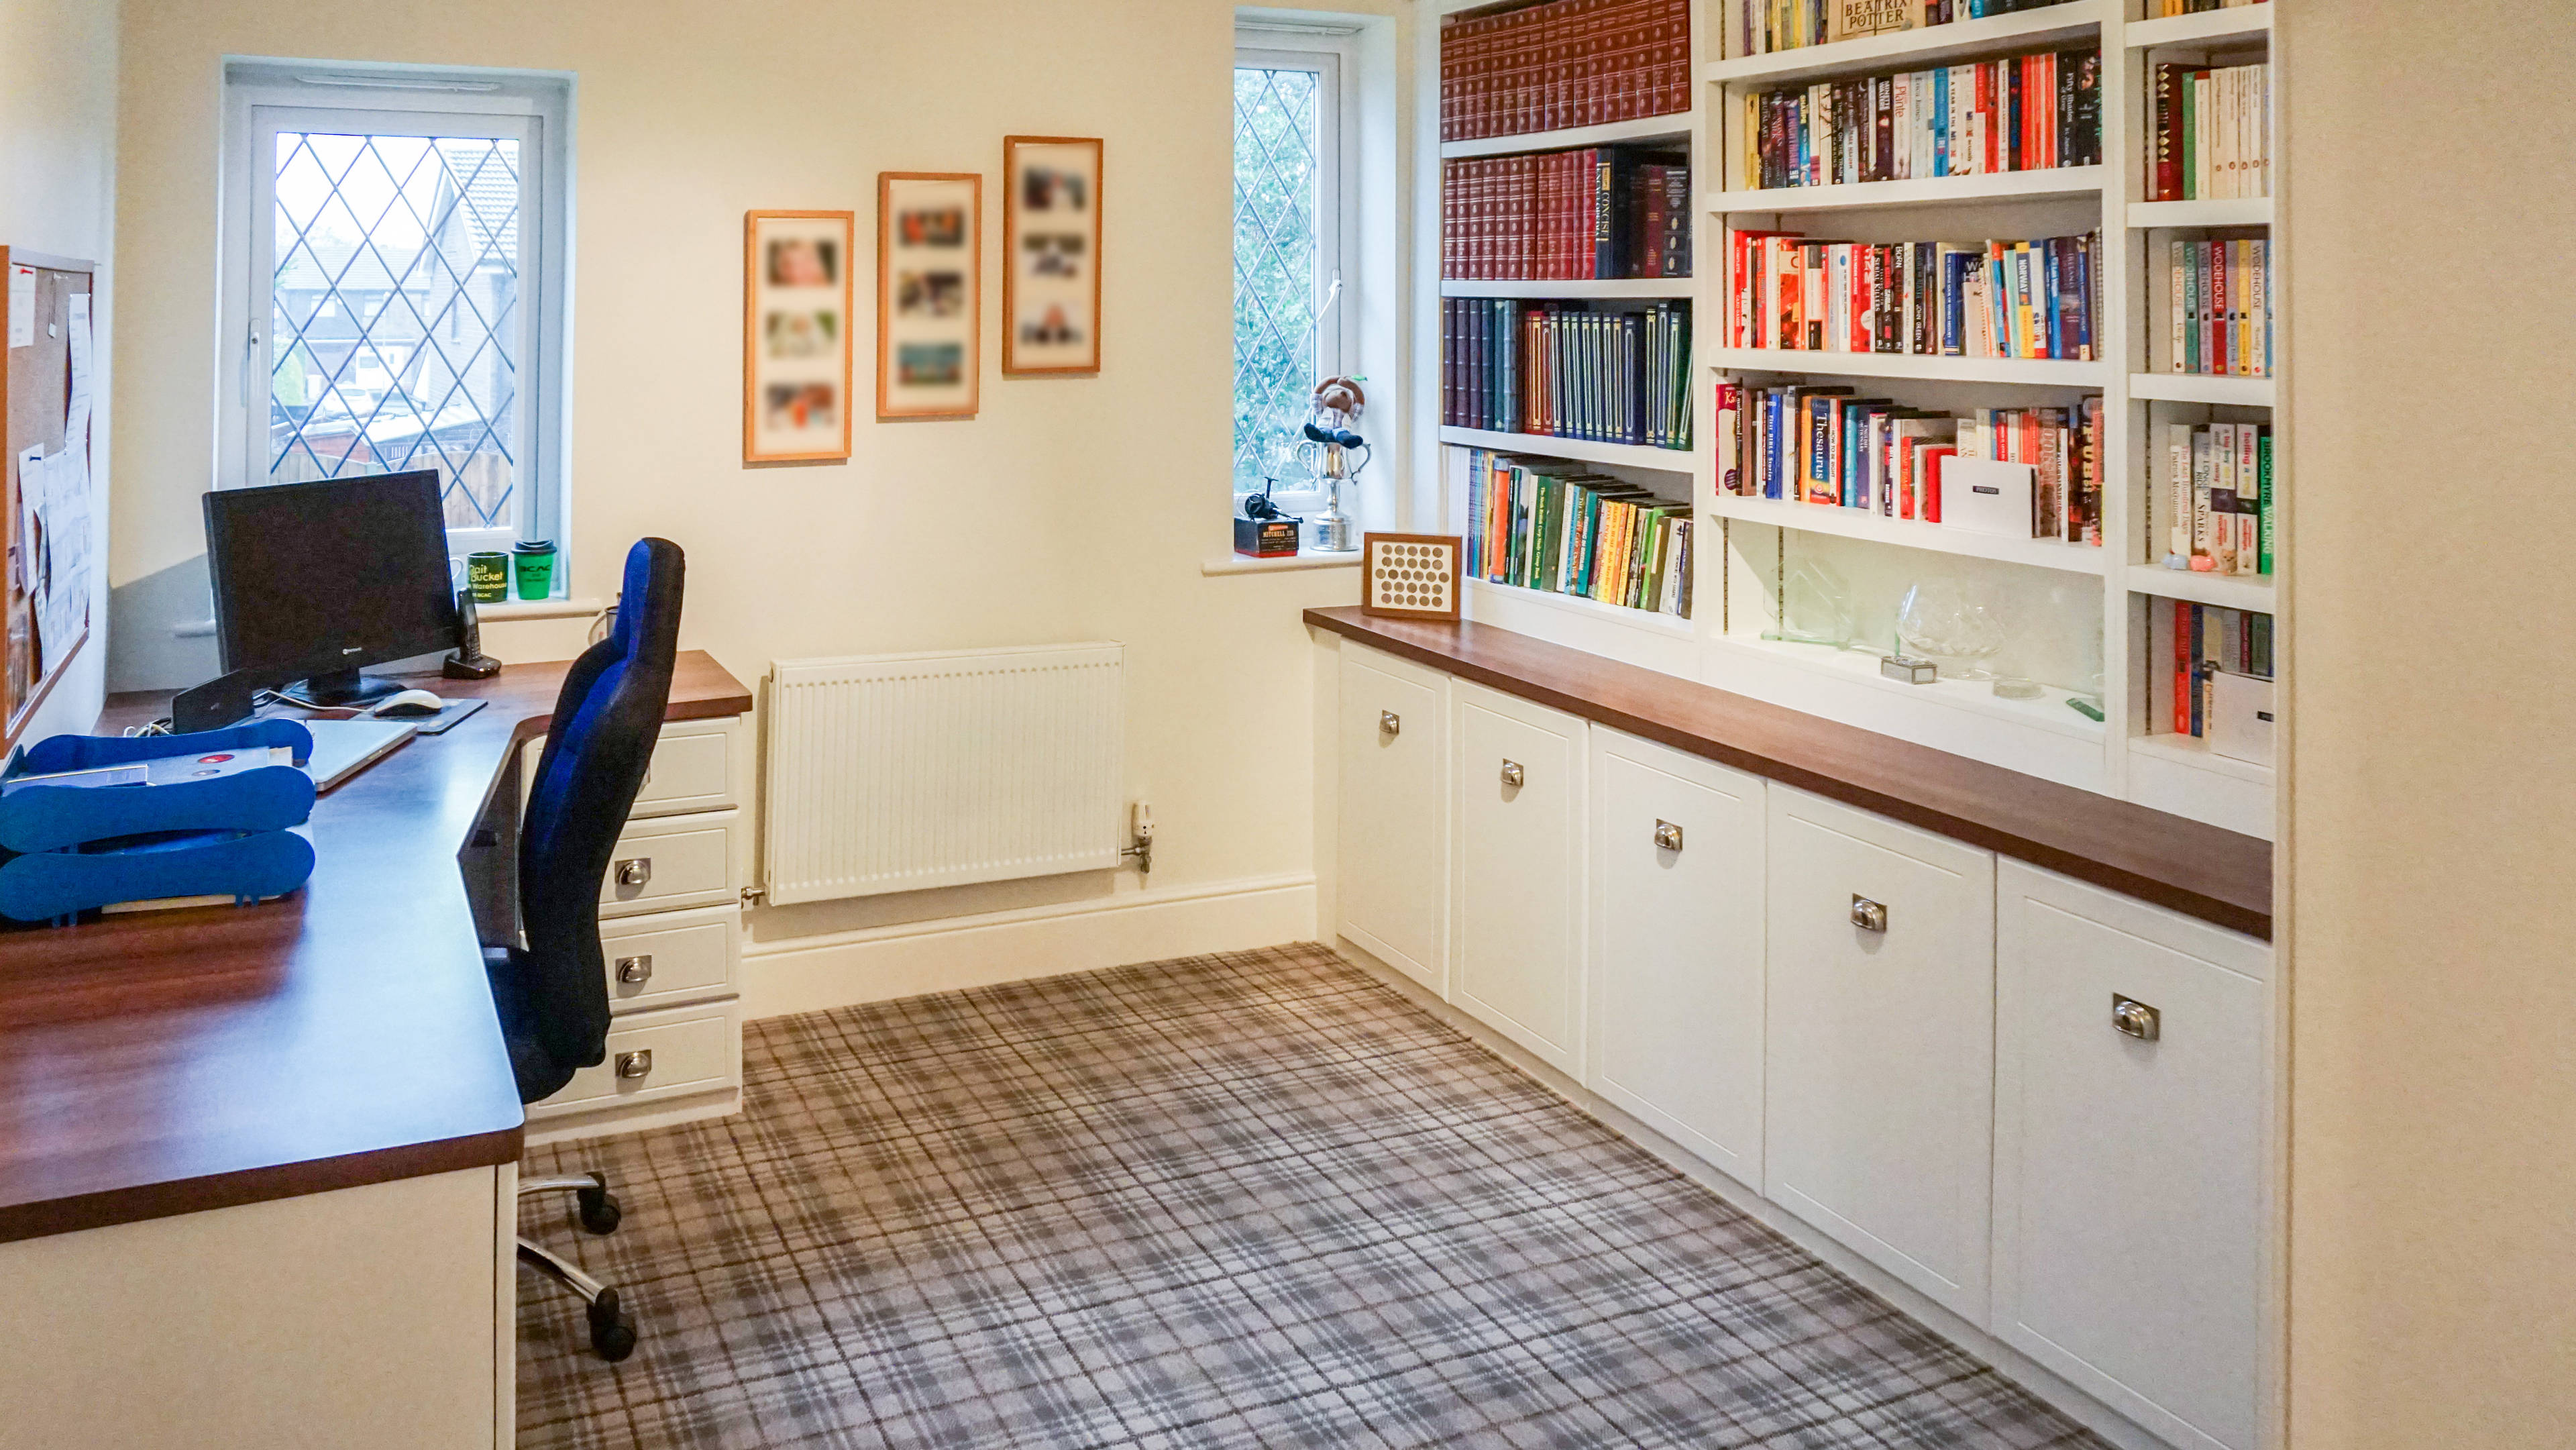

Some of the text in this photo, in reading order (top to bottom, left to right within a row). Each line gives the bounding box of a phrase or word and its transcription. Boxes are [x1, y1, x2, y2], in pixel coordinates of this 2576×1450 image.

[1845, 0, 1907, 16] BEATRIX
[1849, 9, 1904, 29] POTTER
[1894, 85, 1907, 117] Plante
[1915, 76, 1923, 121] Erica James
[2066, 72, 2074, 123] Fifty Shades
[1788, 118, 1799, 168] NIGHTMARE
[1838, 132, 1843, 142] ON
[1601, 193, 1609, 236] CONCISE
[2019, 259, 2029, 293] NORWAY
[2067, 253, 2076, 289] IRELAND
[2186, 246, 2196, 309] WODEHOUSE
[2200, 246, 2209, 309] WODEHOUSE
[2214, 246, 2224, 309] WODEHOUSE
[2253, 246, 2261, 309] WODEHOUSE
[1816, 413, 1827, 479] Thesaurus
[2223, 436, 2231, 448] big
[2223, 450, 2231, 463] boy
[2243, 432, 2252, 464] boiling
[2263, 440, 2272, 554] BROOKMYRE WALKING
[2181, 516, 2189, 535] Days
[2198, 504, 2206, 542] SPARKS
[470, 564, 487, 574] Bait
[471, 572, 504, 582] Bucket
[520, 564, 551, 572] BCAC
